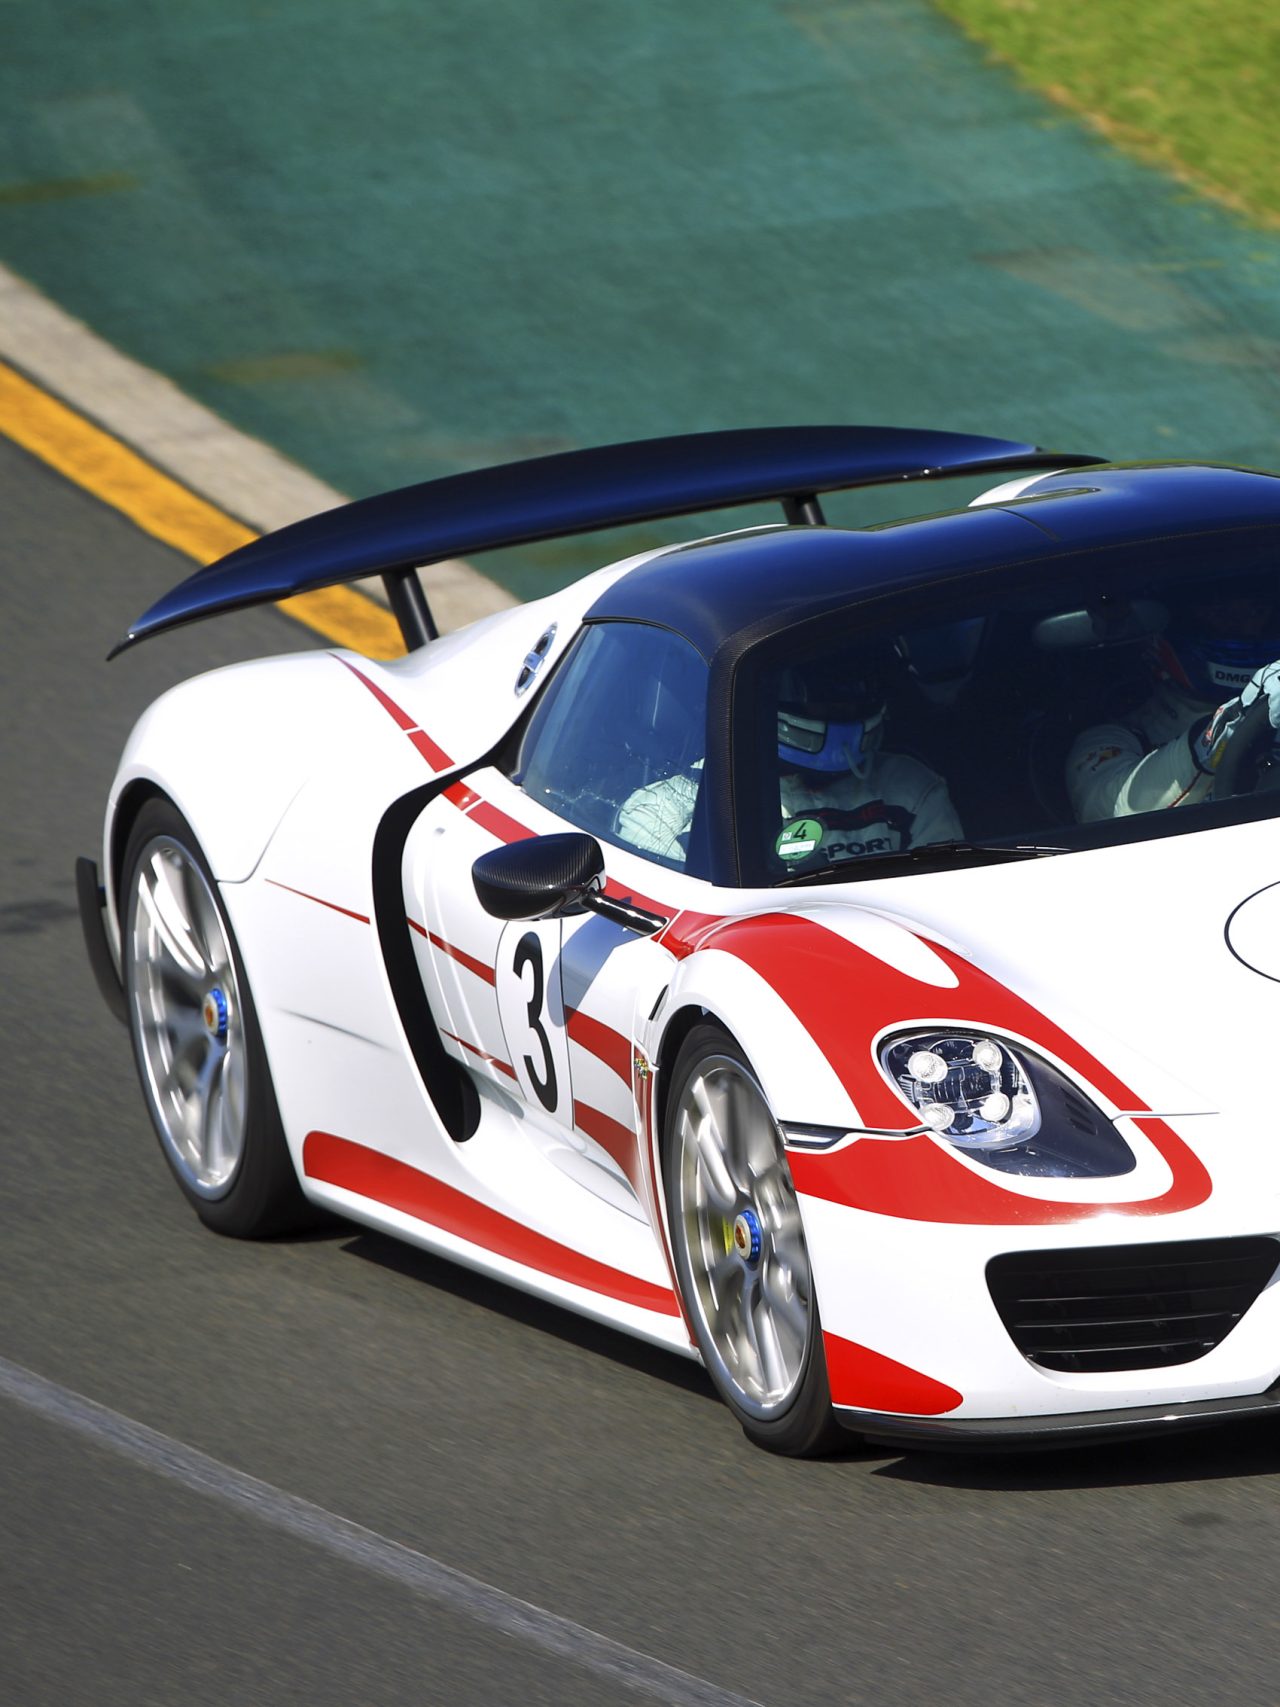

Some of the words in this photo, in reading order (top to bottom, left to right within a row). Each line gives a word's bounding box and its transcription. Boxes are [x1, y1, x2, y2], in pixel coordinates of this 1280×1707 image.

[1215, 671, 1251, 683] DMG
[793, 822, 807, 840] 4
[512, 931, 558, 1113] 3
